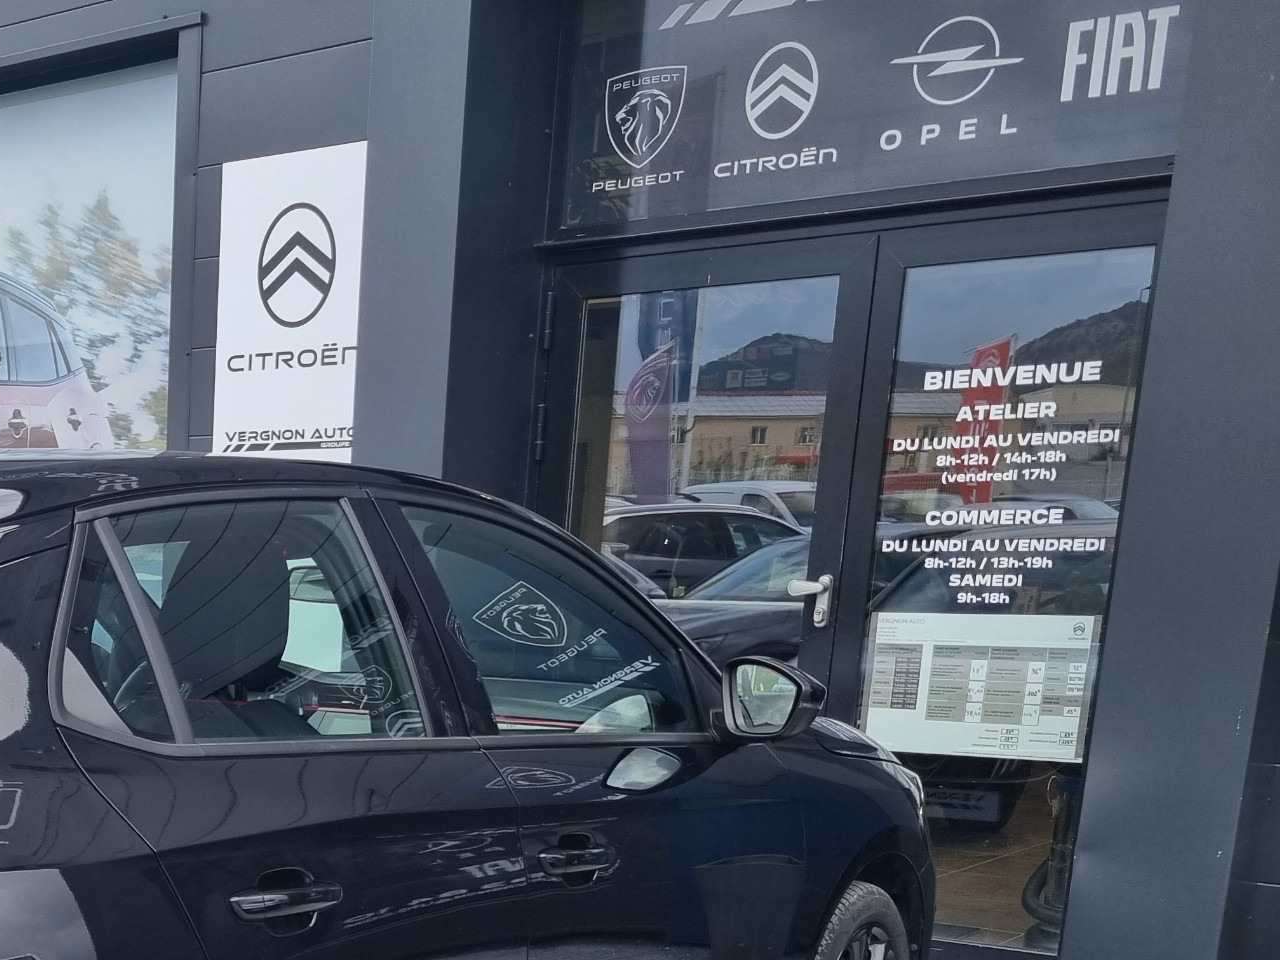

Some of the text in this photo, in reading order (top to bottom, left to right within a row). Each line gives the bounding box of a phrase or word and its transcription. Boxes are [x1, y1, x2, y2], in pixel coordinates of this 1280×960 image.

[1060, 4, 1181, 103] FIAT
[613, 73, 680, 91] PEUGEOT
[880, 118, 1018, 151] OPEL
[591, 170, 685, 193] PEUGEOT
[924, 360, 1102, 391] BIENVENUE
[956, 402, 1057, 422] ATELIER
[225, 429, 305, 443] VERGNON
[893, 429, 1119, 452] DU LUNDI AU VENDREDI
[936, 454, 989, 467] 8h-12h
[1004, 451, 1066, 464] 14h-18h
[941, 468, 1057, 484] (vendredi 17h)
[925, 508, 1064, 526] COMMERCE
[882, 538, 1105, 552] DU LUNDI AU VENDREDI
[924, 556, 976, 569] 8h-12h
[990, 556, 1053, 569] 13h-19h
[949, 574, 1023, 587] SAMEDI
[957, 591, 1010, 605] 9h-18h
